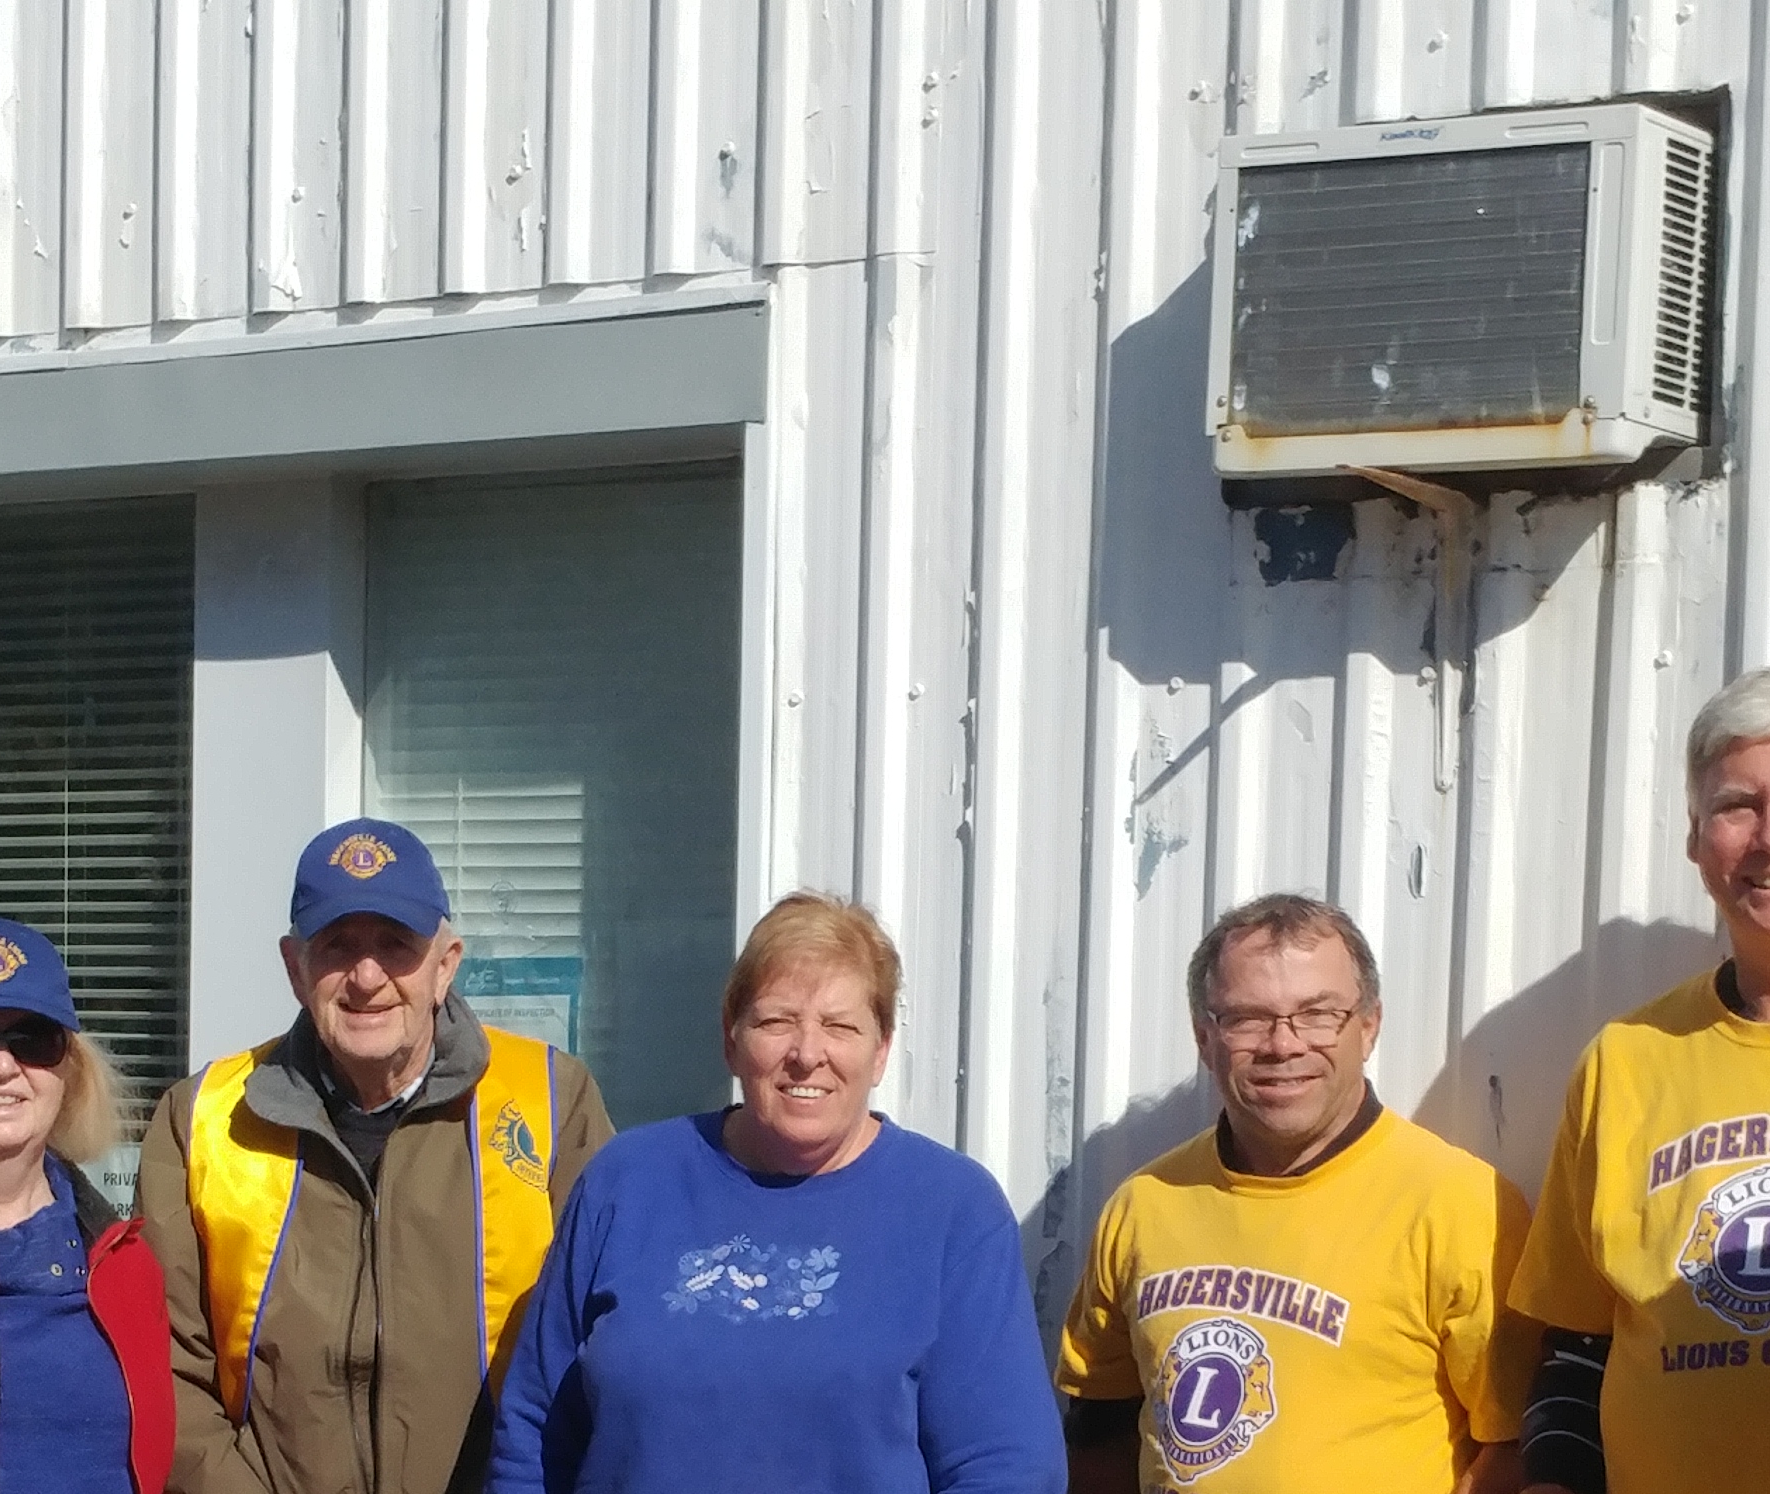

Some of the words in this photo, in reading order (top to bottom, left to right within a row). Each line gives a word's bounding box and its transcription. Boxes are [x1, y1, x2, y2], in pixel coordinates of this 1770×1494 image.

[1138, 1266, 1348, 1345] HAGERSVILLE
[1186, 1330, 1255, 1360] LIONS
[1660, 1339, 1750, 1373] LIONS
[1180, 1366, 1222, 1429] L
